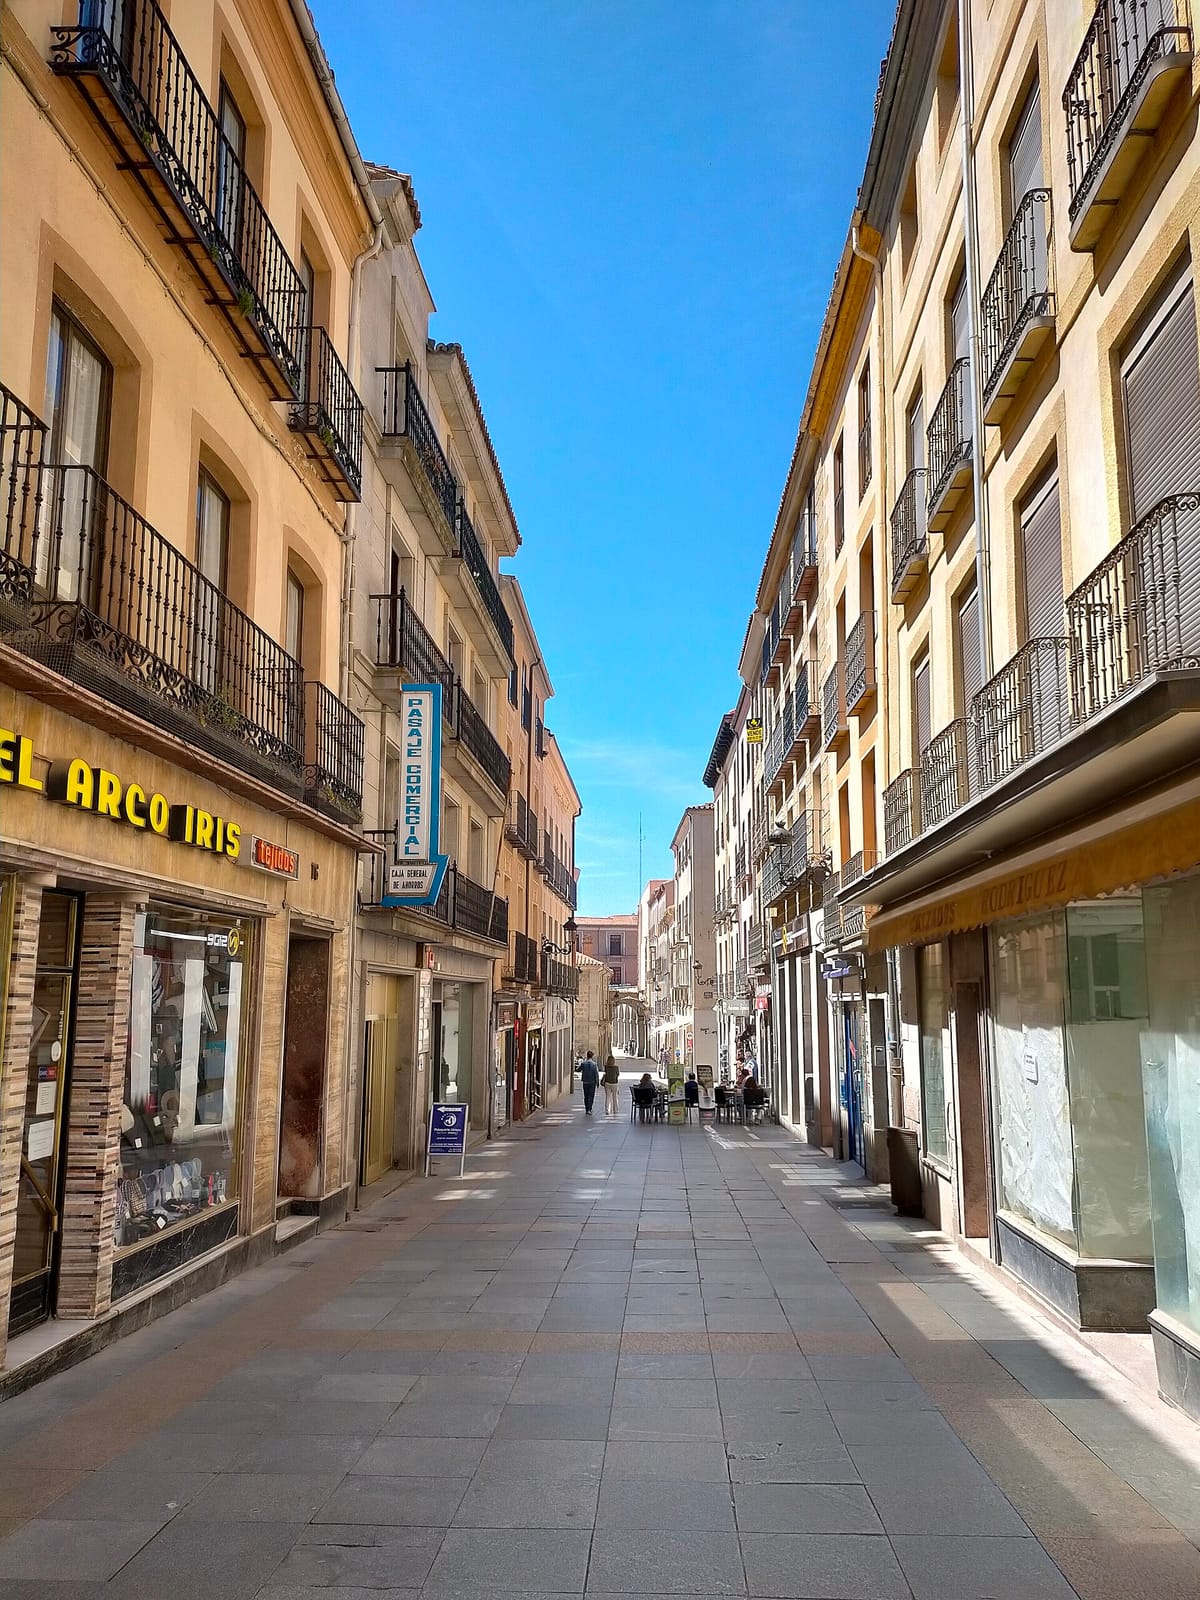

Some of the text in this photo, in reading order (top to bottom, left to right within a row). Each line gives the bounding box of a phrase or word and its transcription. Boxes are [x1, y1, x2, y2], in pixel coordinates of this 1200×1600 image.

[0, 728, 241, 858] EL ARCO IRIS
[405, 698, 423, 855] PASAJE COMERCIAL
[258, 839, 295, 873] tejidos
[391, 869, 428, 878] CAJA GENERAL
[393, 881, 400, 889] DE
